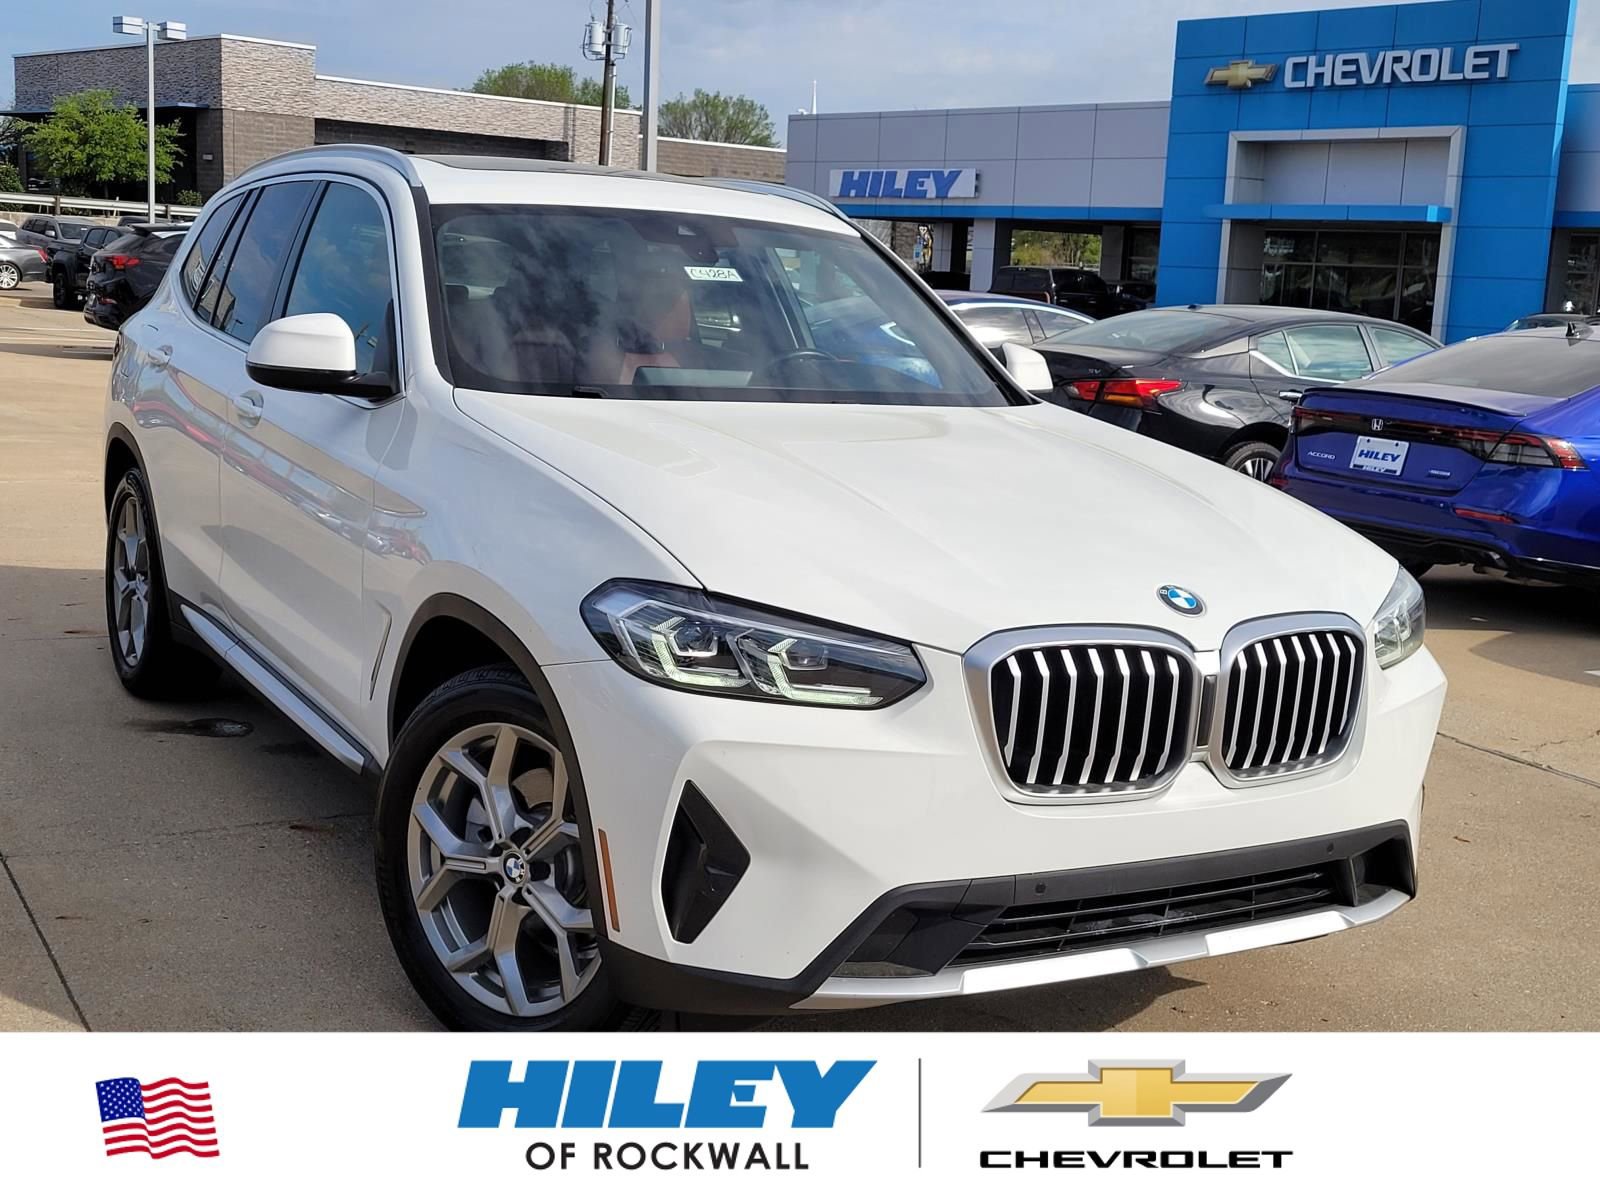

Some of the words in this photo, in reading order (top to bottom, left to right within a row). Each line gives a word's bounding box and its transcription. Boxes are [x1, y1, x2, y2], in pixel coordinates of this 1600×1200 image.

[1284, 43, 1520, 89] CHEVROLET
[838, 170, 962, 198] HILEY
[1307, 451, 1336, 460] ACCORD
[1358, 449, 1401, 462] HILEY
